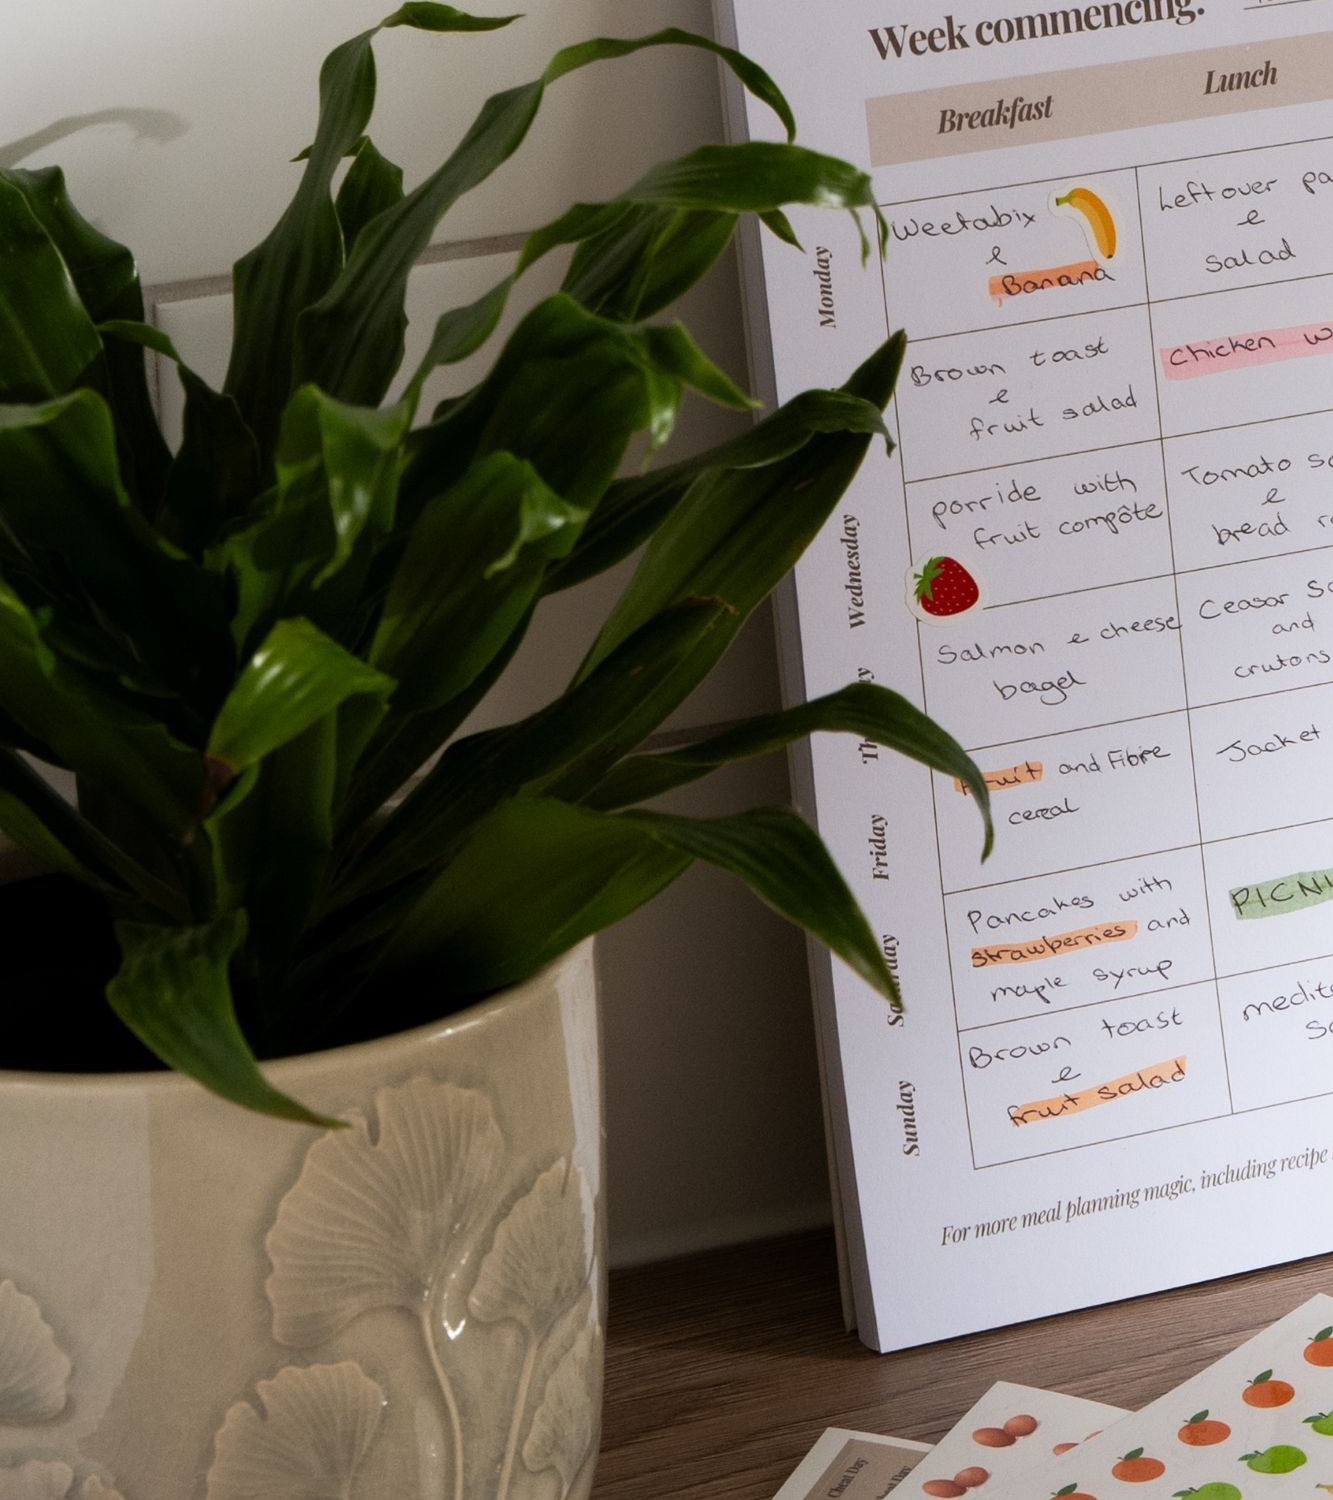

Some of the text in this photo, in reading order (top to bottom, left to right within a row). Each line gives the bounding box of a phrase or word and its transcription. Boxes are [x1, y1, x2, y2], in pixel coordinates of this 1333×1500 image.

[869, 13, 971, 61] Week
[1203, 60, 1279, 97] Lunch
[936, 94, 1054, 136] Breakfast
[819, 246, 836, 329] Monday
[910, 362, 1007, 388] Brown
[844, 514, 862, 630] Wednesday
[869, 815, 889, 881] Friday
[897, 1079, 920, 1157] Sunday
[941, 1225, 971, 1246] For
[974, 1216, 1018, 1239] more
[1021, 1201, 1062, 1228] meal
[1065, 1186, 1140, 1224] planning
[1142, 1174, 1196, 1207] magic,
[1280, 1147, 1328, 1172] including
[848, 1456, 869, 1478] Day
